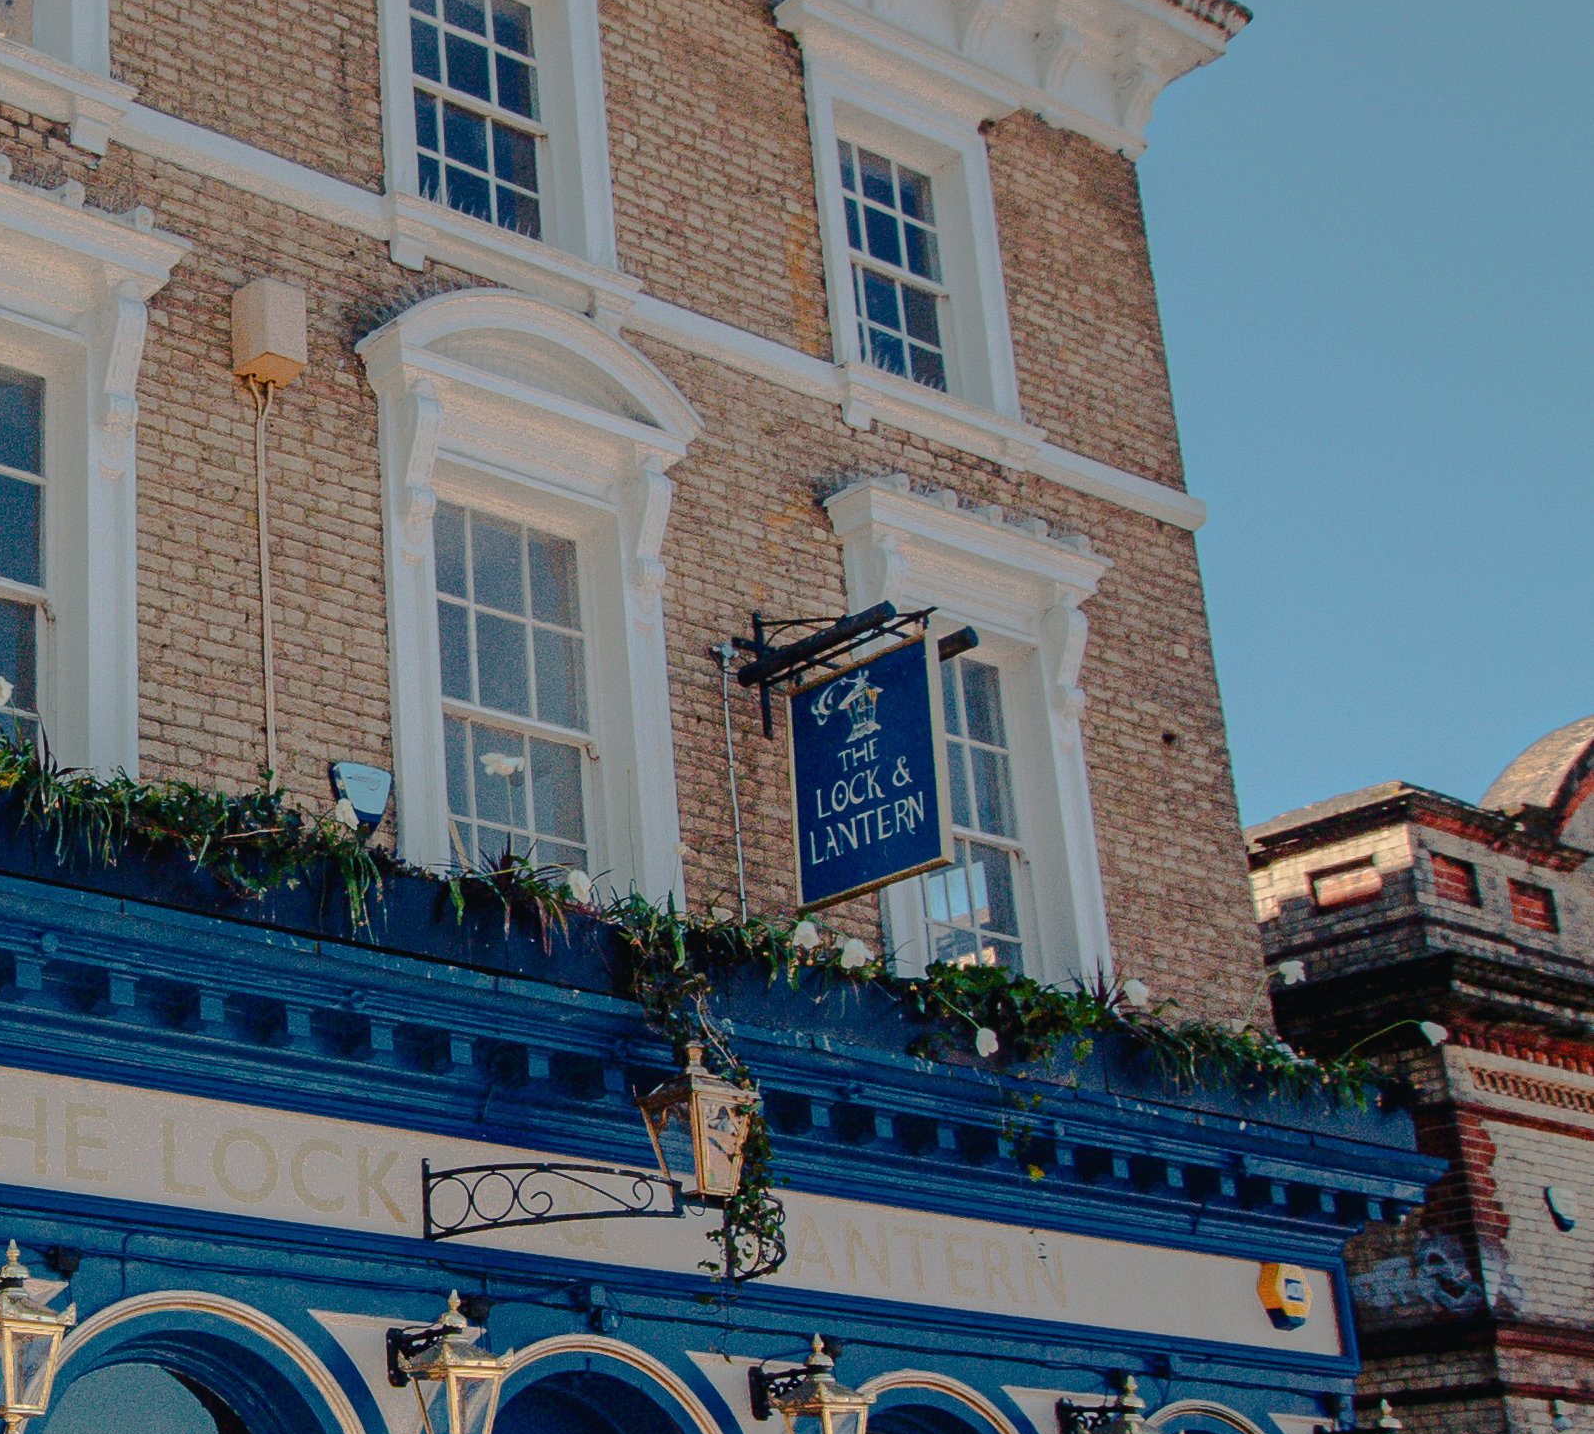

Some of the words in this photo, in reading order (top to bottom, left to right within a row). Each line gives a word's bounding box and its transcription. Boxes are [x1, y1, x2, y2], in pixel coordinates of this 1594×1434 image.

[816, 765, 886, 819] LOCK
[892, 756, 913, 787] &
[837, 737, 880, 772] THE
[809, 790, 925, 865] LANTERN
[160, 1117, 409, 1225] LOCK
[752, 1212, 1069, 1309] ANTERN
